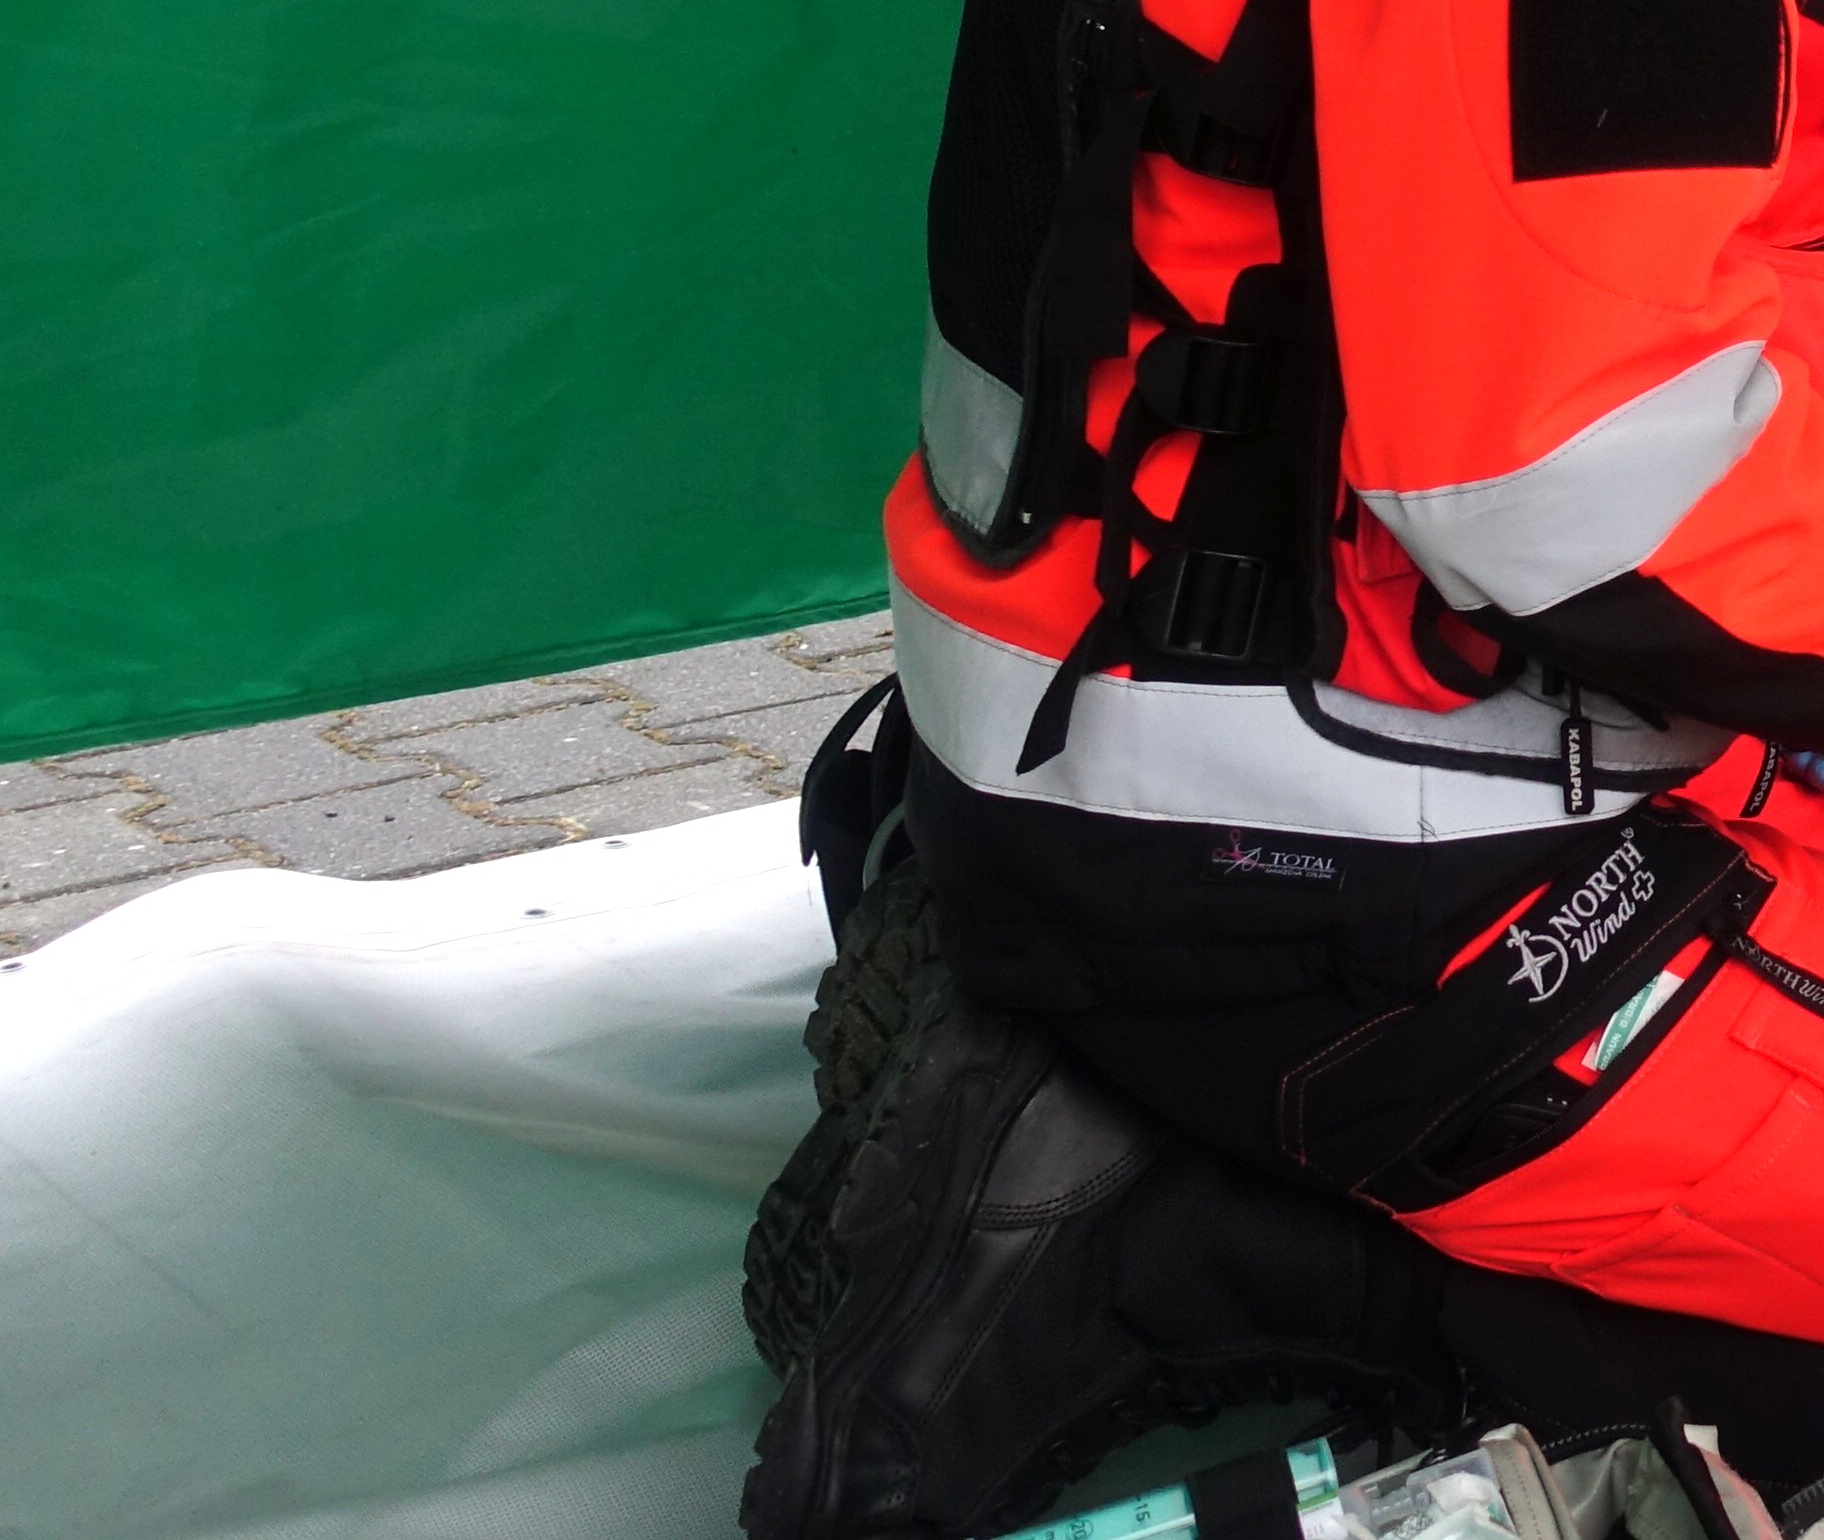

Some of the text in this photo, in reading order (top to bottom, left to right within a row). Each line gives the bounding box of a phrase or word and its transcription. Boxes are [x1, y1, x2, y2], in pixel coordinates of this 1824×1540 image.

[1567, 727, 1584, 811] KABAPOL
[1749, 741, 1777, 811] ABAPOL
[1270, 851, 1336, 872] TOTAL
[1548, 840, 1646, 942] NORTH
[1570, 891, 1637, 962] Wind
